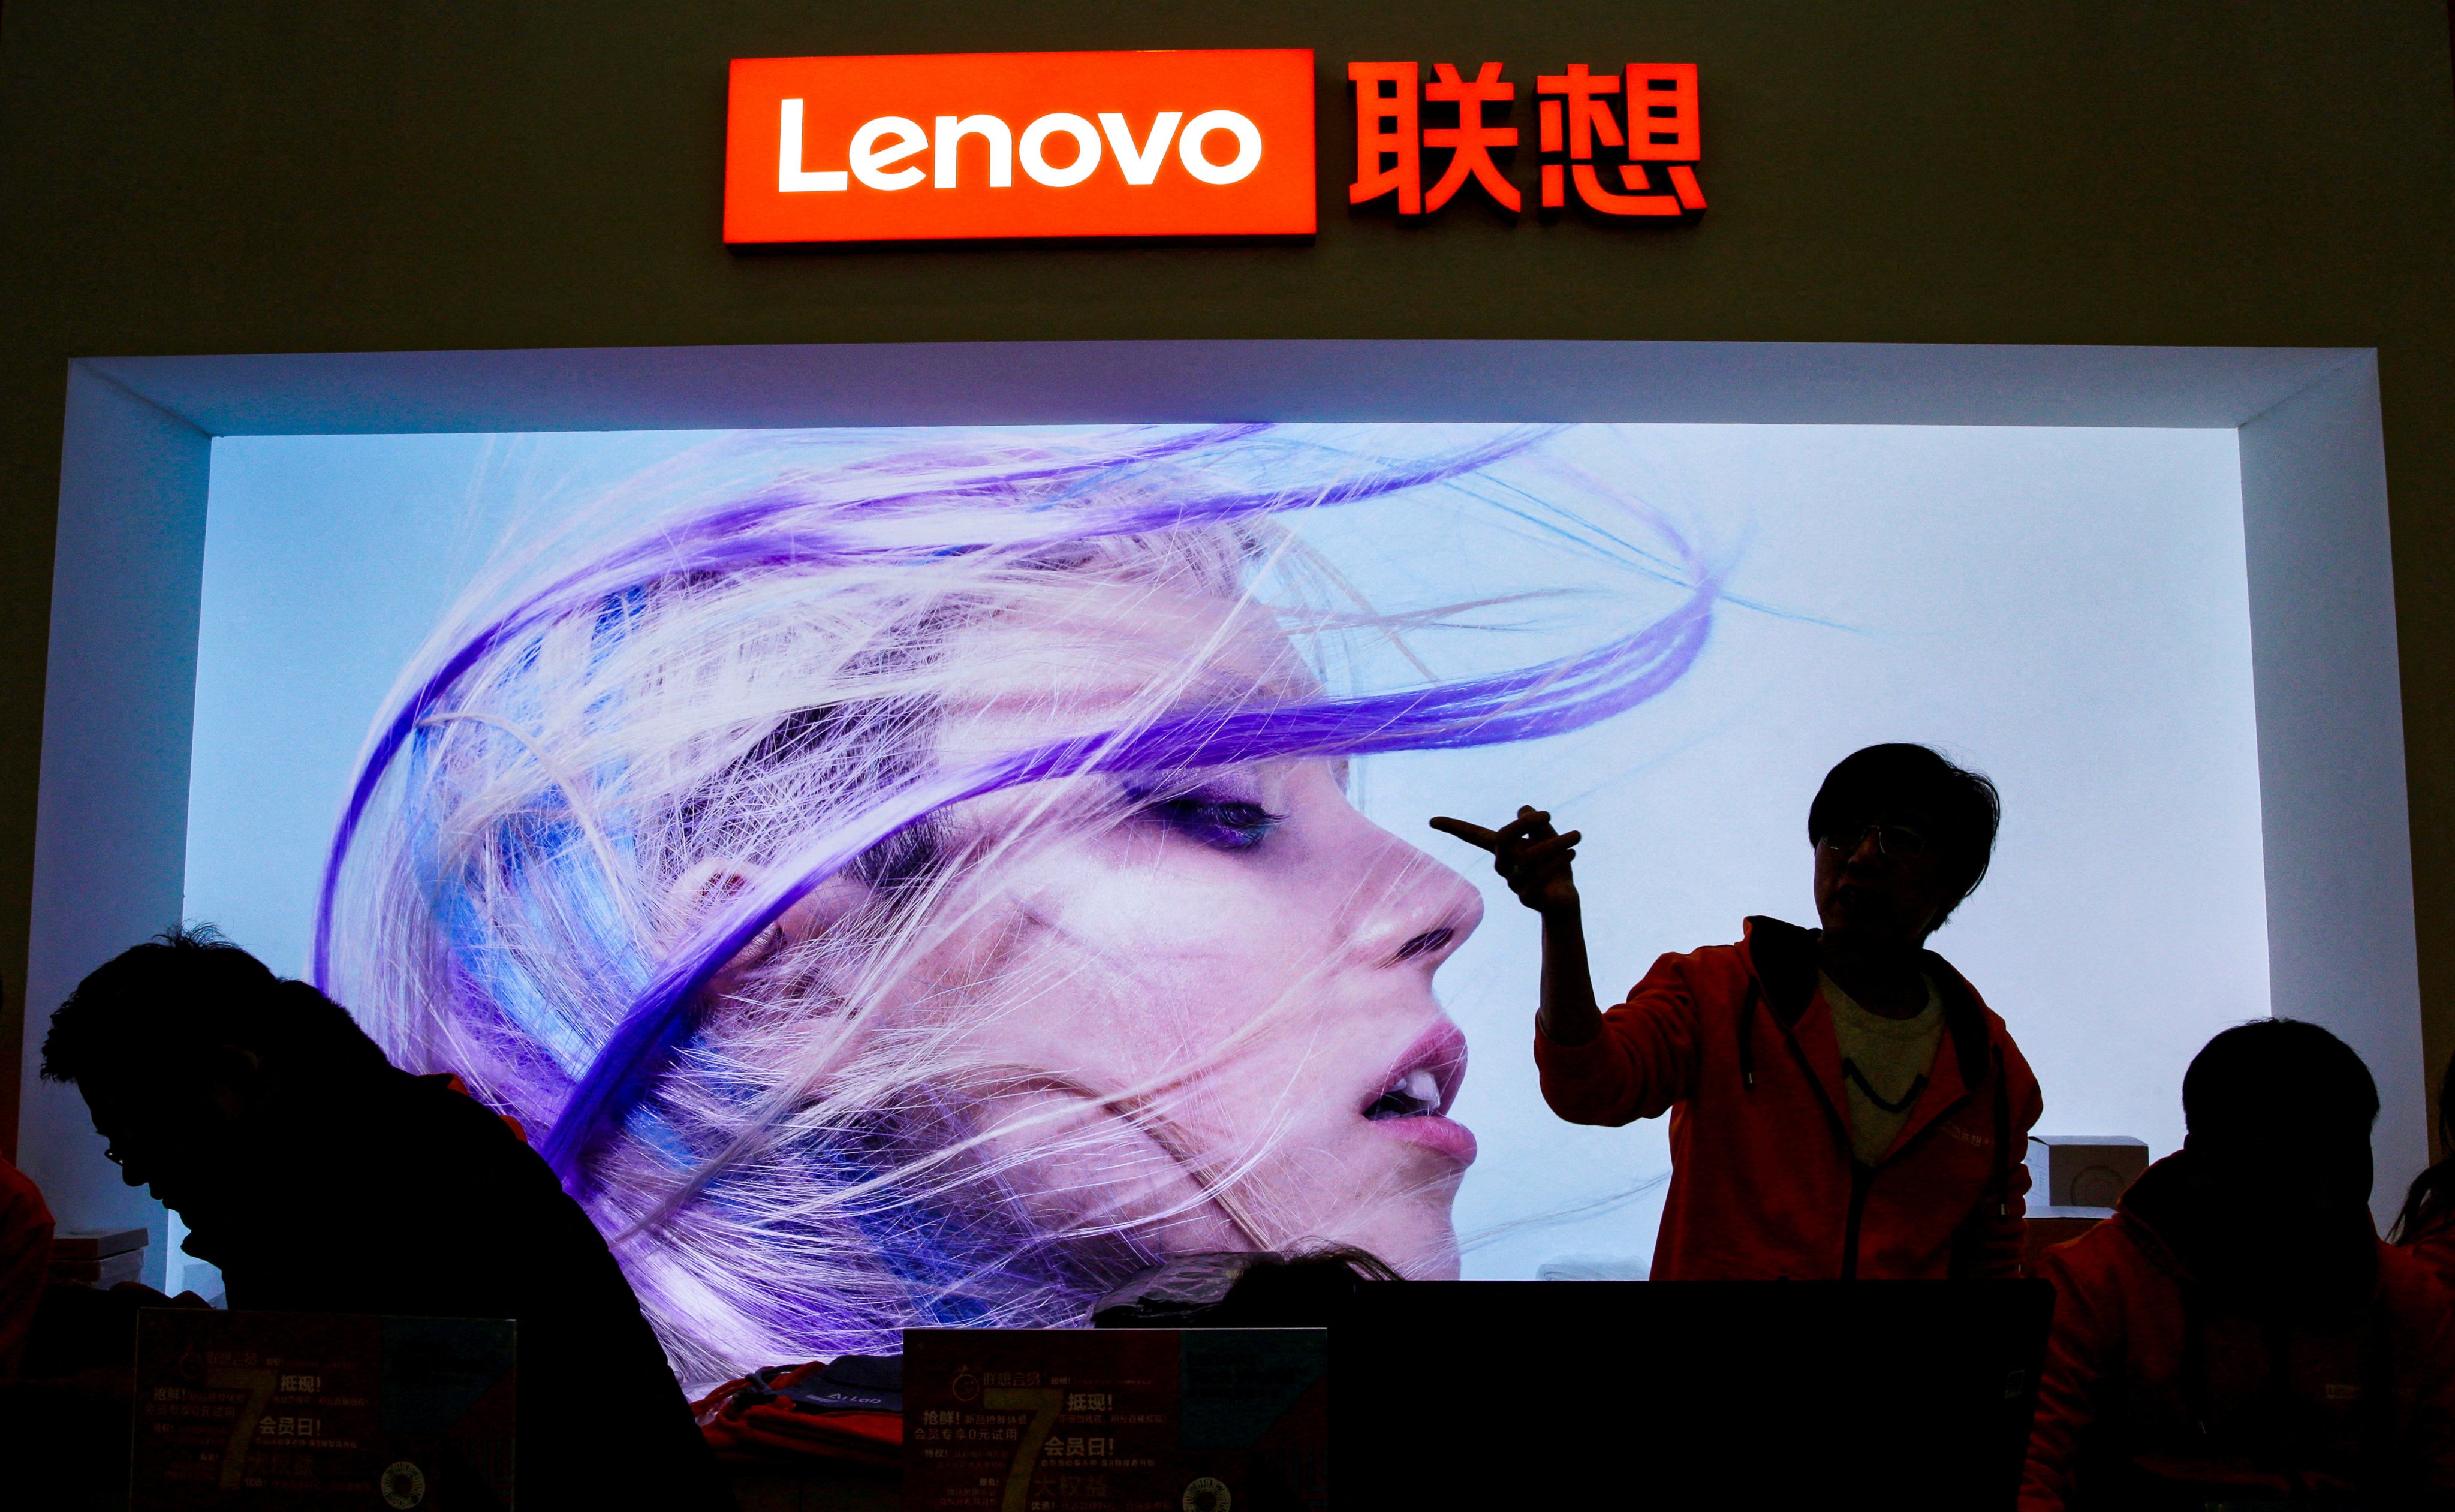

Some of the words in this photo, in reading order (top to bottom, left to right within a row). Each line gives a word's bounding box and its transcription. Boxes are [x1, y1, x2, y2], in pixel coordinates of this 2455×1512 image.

[778, 98, 1262, 192] Lenovo
[1348, 62, 1707, 216] 联想
[1068, 1393, 1113, 1411] 抵现!
[260, 1415, 321, 1436] 会员日!
[923, 1410, 960, 1425] 抢鲜!
[914, 1428, 1017, 1441] 会员专享0元试用
[1044, 1436, 1114, 1456] 会员日!
